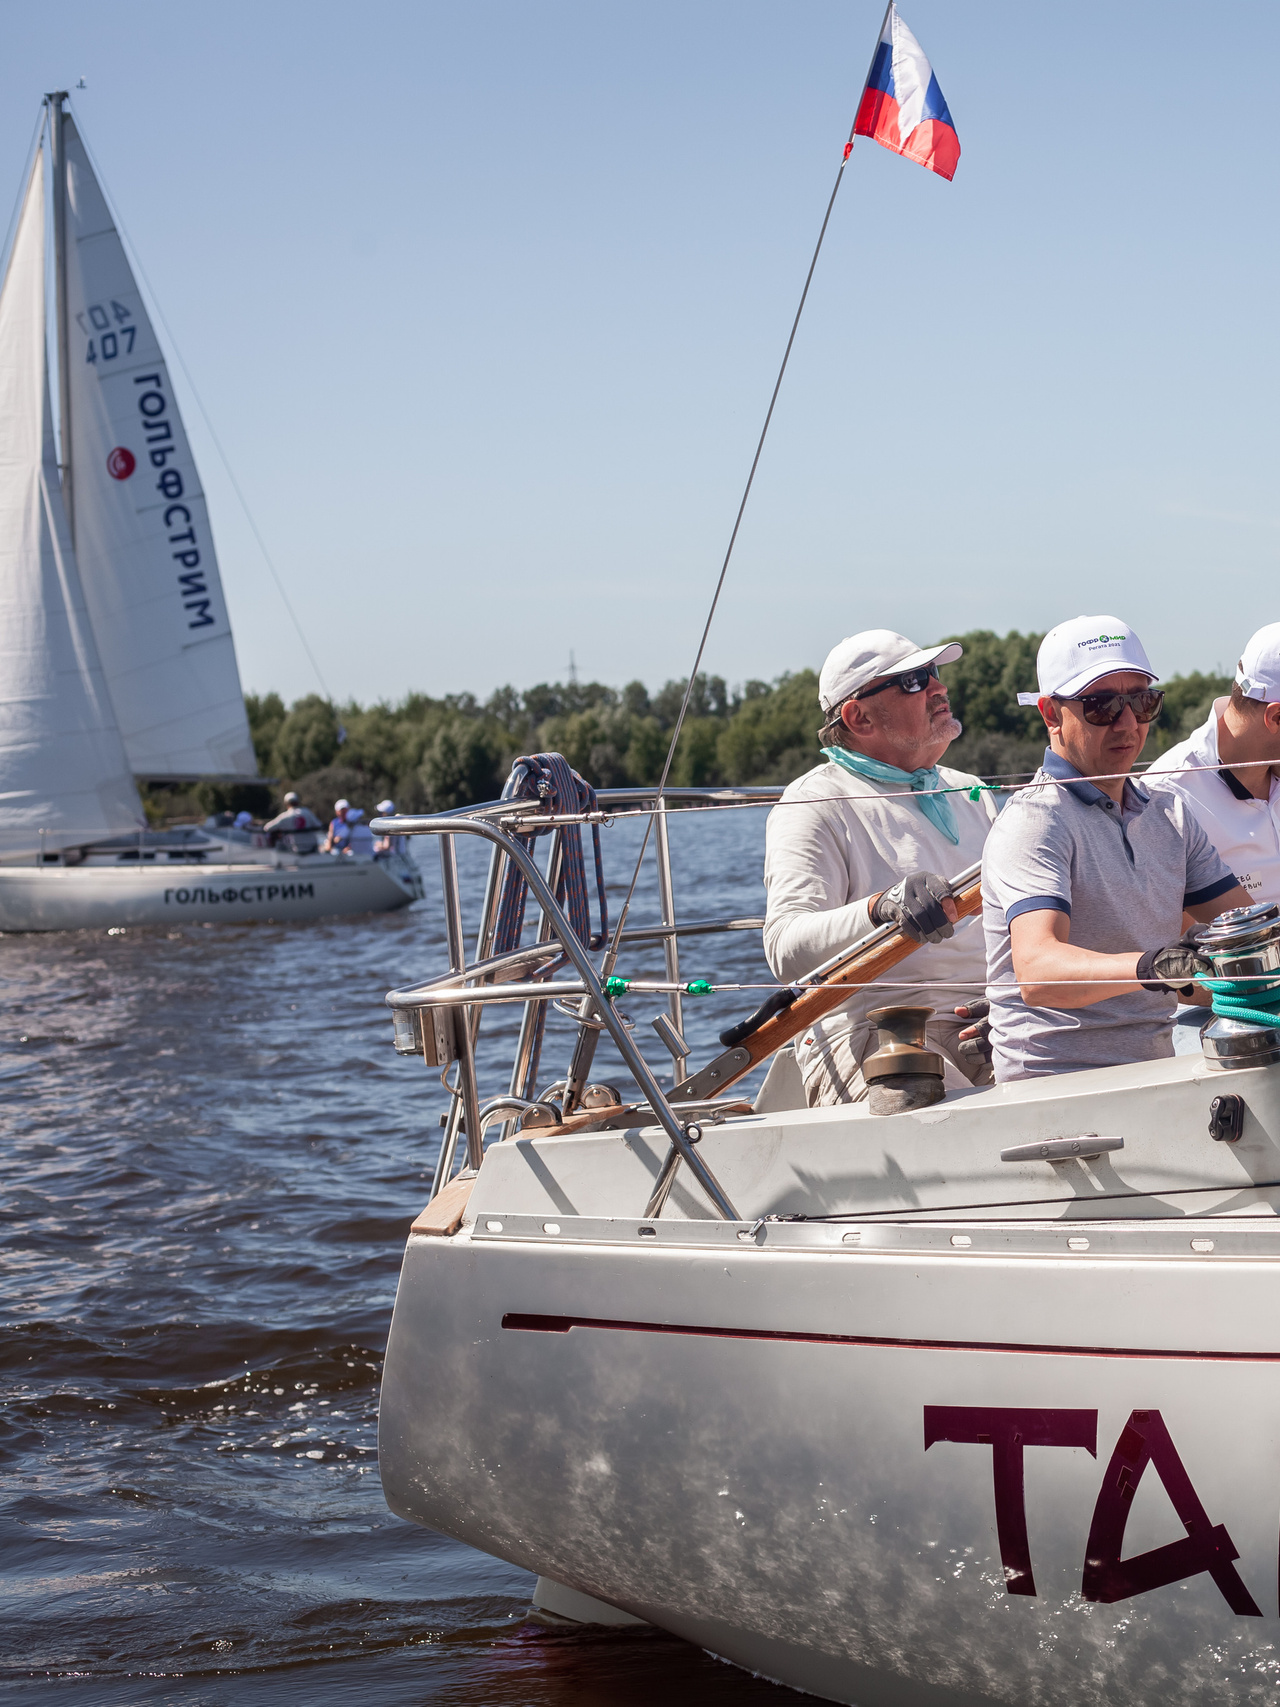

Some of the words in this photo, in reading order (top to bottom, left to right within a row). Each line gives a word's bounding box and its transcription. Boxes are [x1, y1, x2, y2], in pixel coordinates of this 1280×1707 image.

[86, 324, 137, 365] 407
[133, 373, 216, 631] ГОЛЬФСТРИМ
[164, 883, 315, 904] ГОЛЬФСТРИМ
